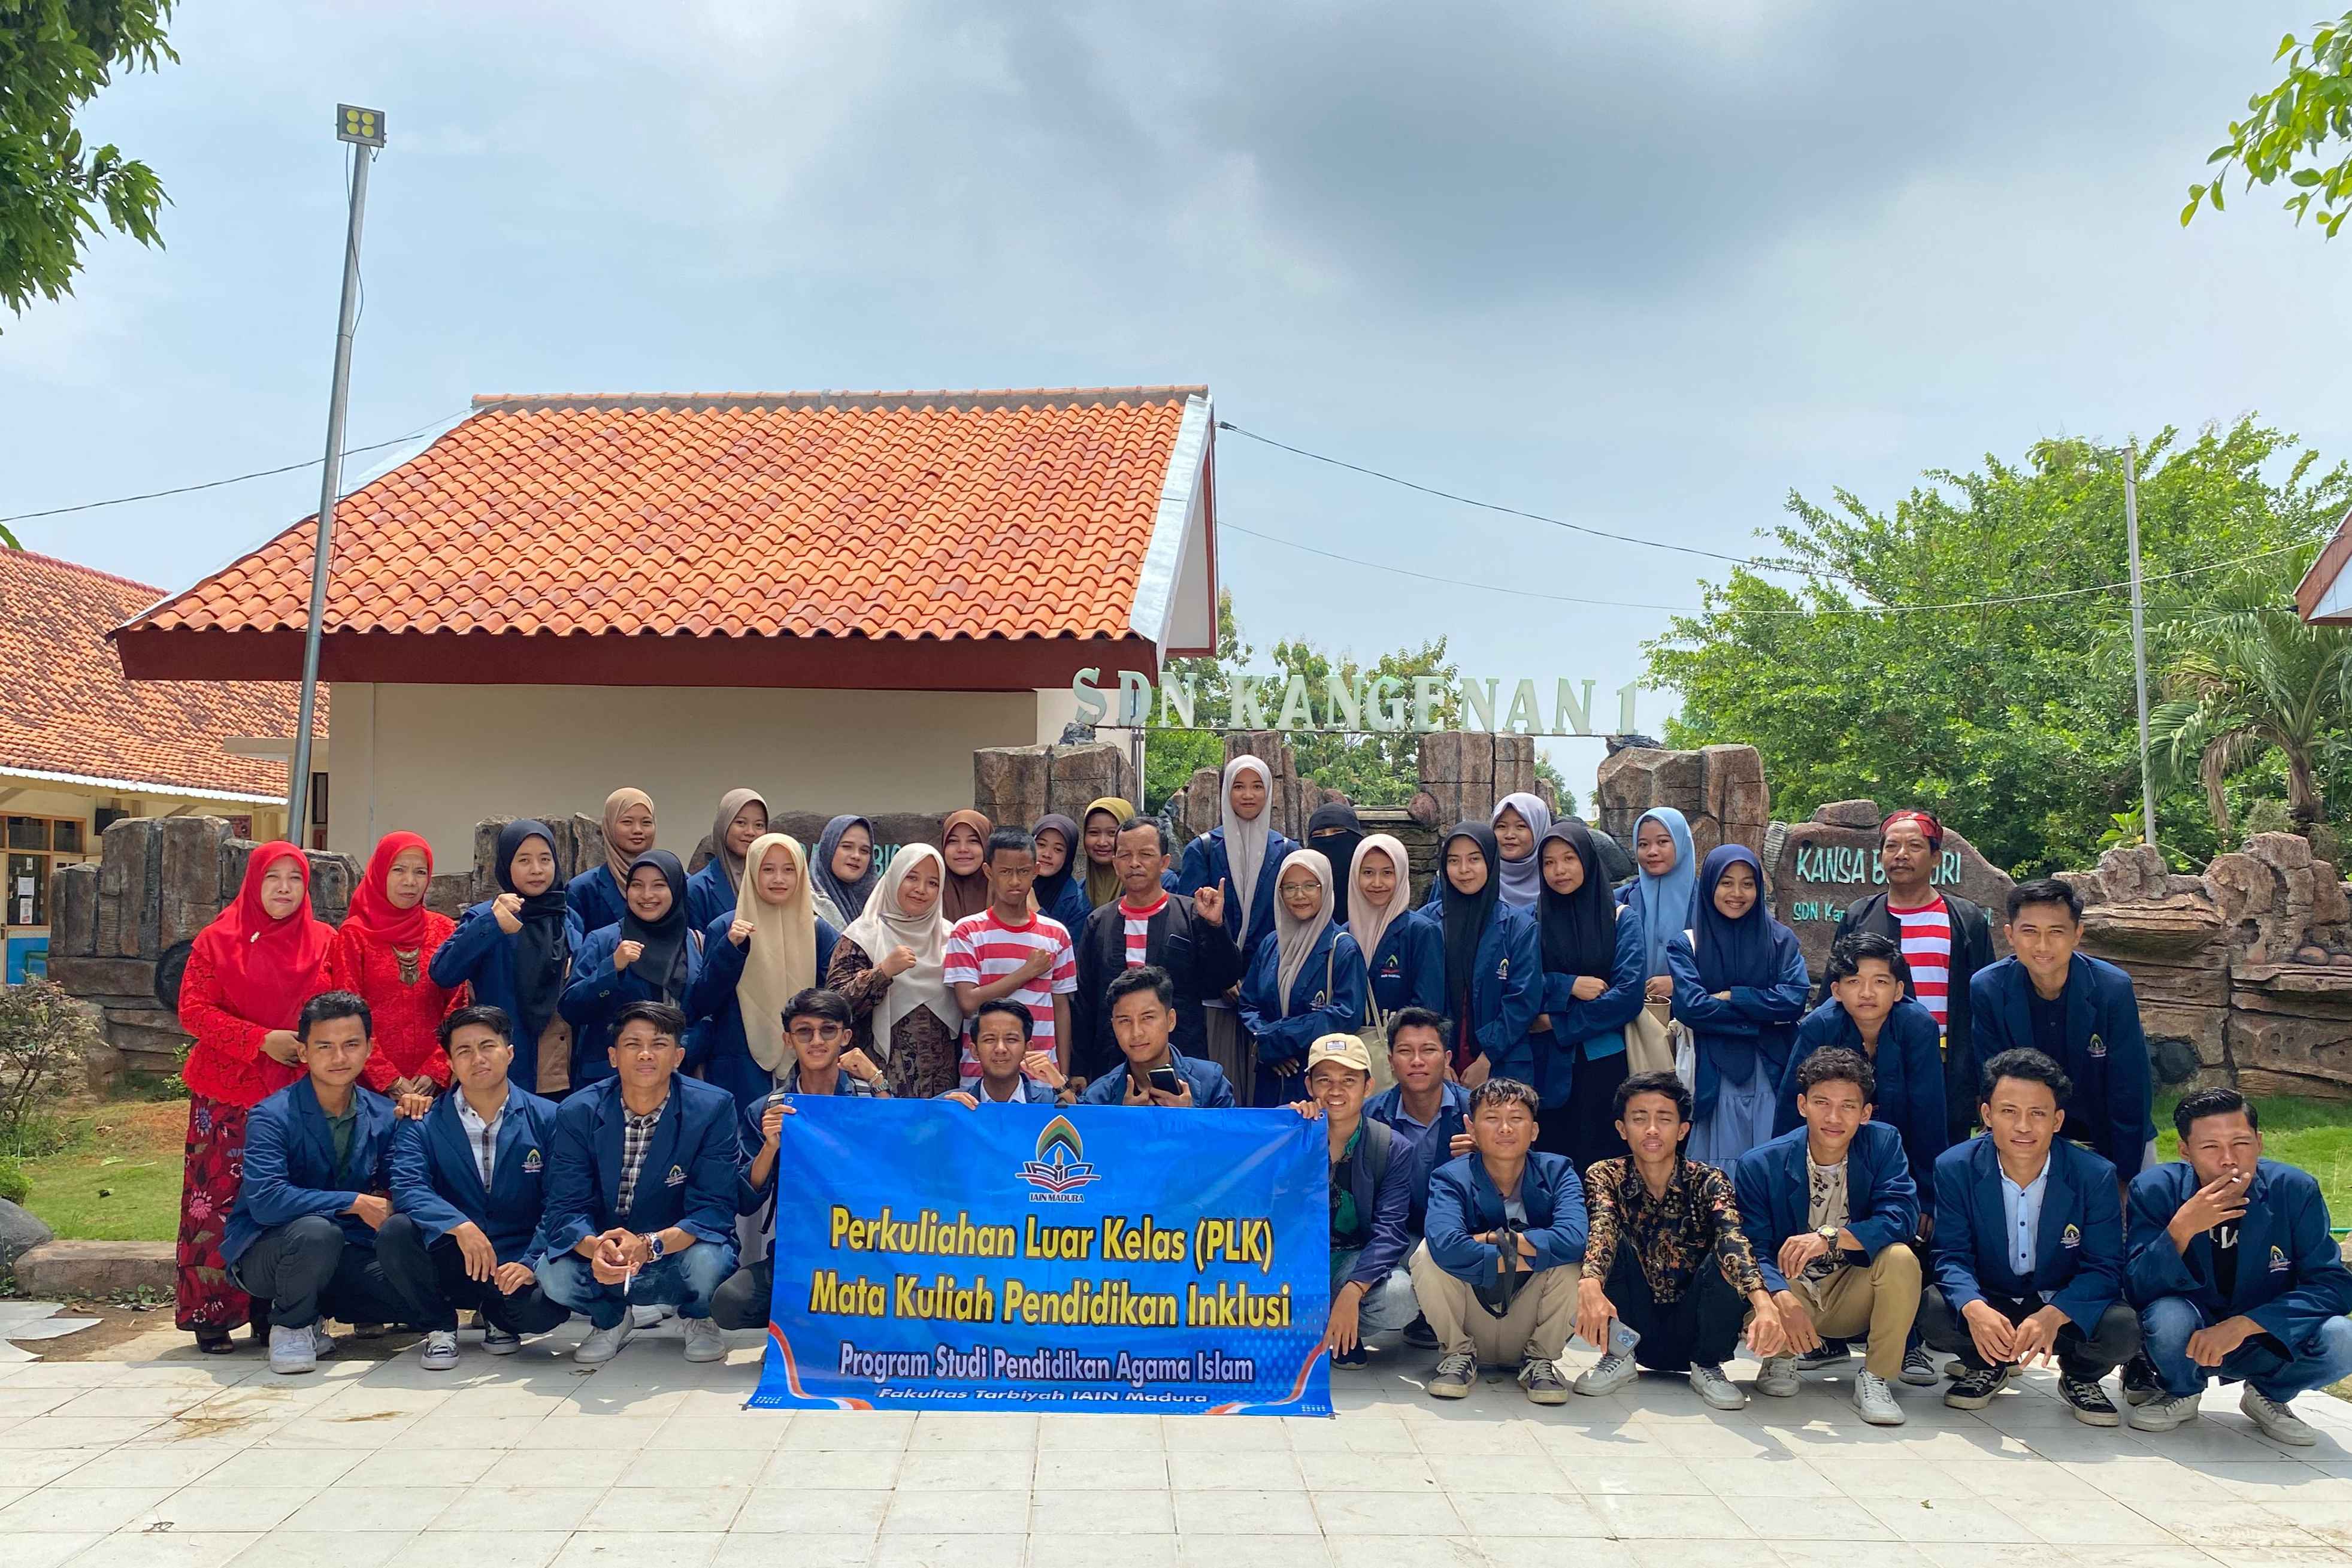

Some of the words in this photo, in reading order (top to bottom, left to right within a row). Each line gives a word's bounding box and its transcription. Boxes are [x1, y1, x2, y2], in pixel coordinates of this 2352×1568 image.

[1072, 667, 1196, 728] SDN
[1228, 674, 1596, 736] KANGENAN
[1615, 680, 1637, 736] 1
[1797, 846, 1866, 884] KANSA
[1793, 901, 1818, 921] SDN
[1030, 1193, 1048, 1201] IAIN
[1049, 1194, 1084, 1202] MADURA
[831, 1206, 1016, 1257] Perkuliahan
[1025, 1216, 1094, 1259] Luar
[1103, 1216, 1186, 1261] Kelas
[1195, 1219, 1273, 1273] (PLK)
[810, 1271, 885, 1316] Mata
[895, 1275, 992, 1321] Kuliah
[1003, 1279, 1177, 1325] Pendidikan
[1188, 1282, 1290, 1327] Inklusi
[840, 1342, 929, 1384] Program
[936, 1345, 988, 1378] Studi
[993, 1348, 1109, 1379] Pendidikan
[1116, 1352, 1191, 1388] Agama
[1198, 1351, 1254, 1381] Islam
[878, 1388, 968, 1399] Fakultas
[975, 1390, 1065, 1402] Tarbiyah
[1071, 1391, 1119, 1401] IAIN
[1125, 1391, 1207, 1403] Madura
